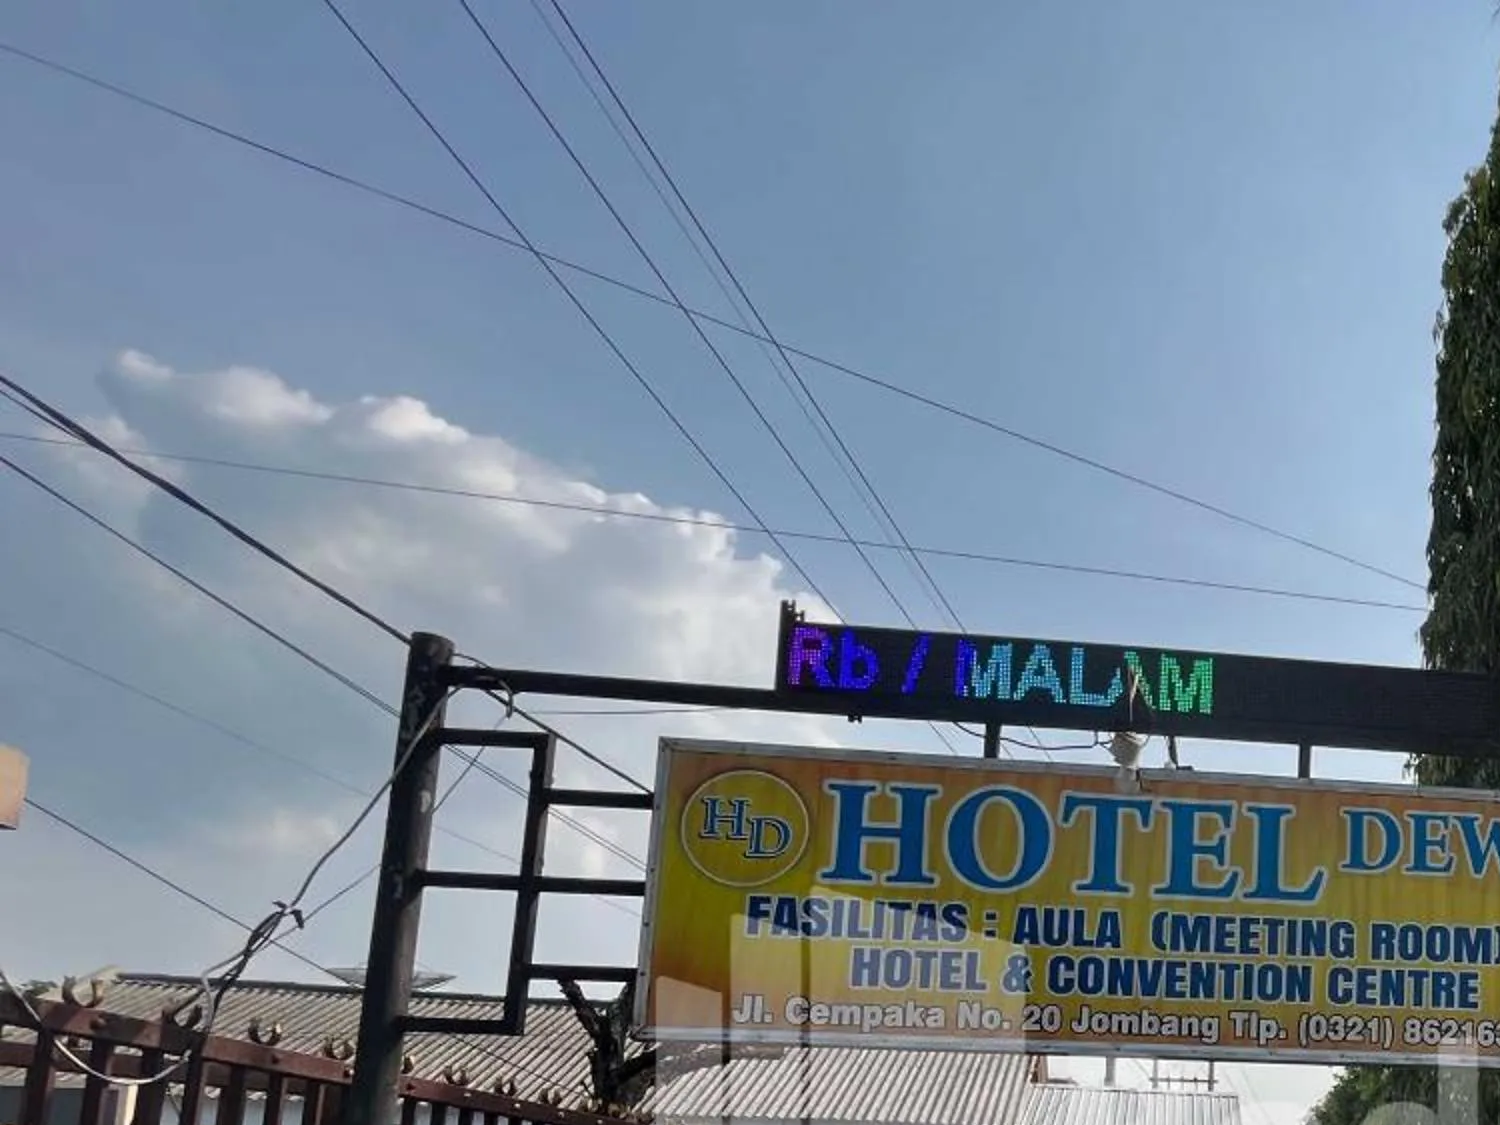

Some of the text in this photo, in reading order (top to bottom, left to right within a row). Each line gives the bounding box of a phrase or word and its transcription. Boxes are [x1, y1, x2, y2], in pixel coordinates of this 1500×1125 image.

[787, 625, 1214, 714] Rb / MALAM
[816, 777, 1328, 904] HOTEL
[743, 894, 972, 943] FASILITAS
[1011, 904, 1124, 948] AULA
[1151, 910, 1357, 960] (MEETING
[848, 945, 1481, 1011] HOTEL & CONVENTION CENTRE
[731, 993, 774, 1024] Jl.
[784, 996, 946, 1033] Cempaka
[956, 1001, 1011, 1031] No.
[1021, 1004, 1063, 1033] 20
[1071, 1006, 1220, 1045] Jombang
[1229, 1010, 1288, 1045] Tlp.
[1298, 1014, 1395, 1049] (0321)
